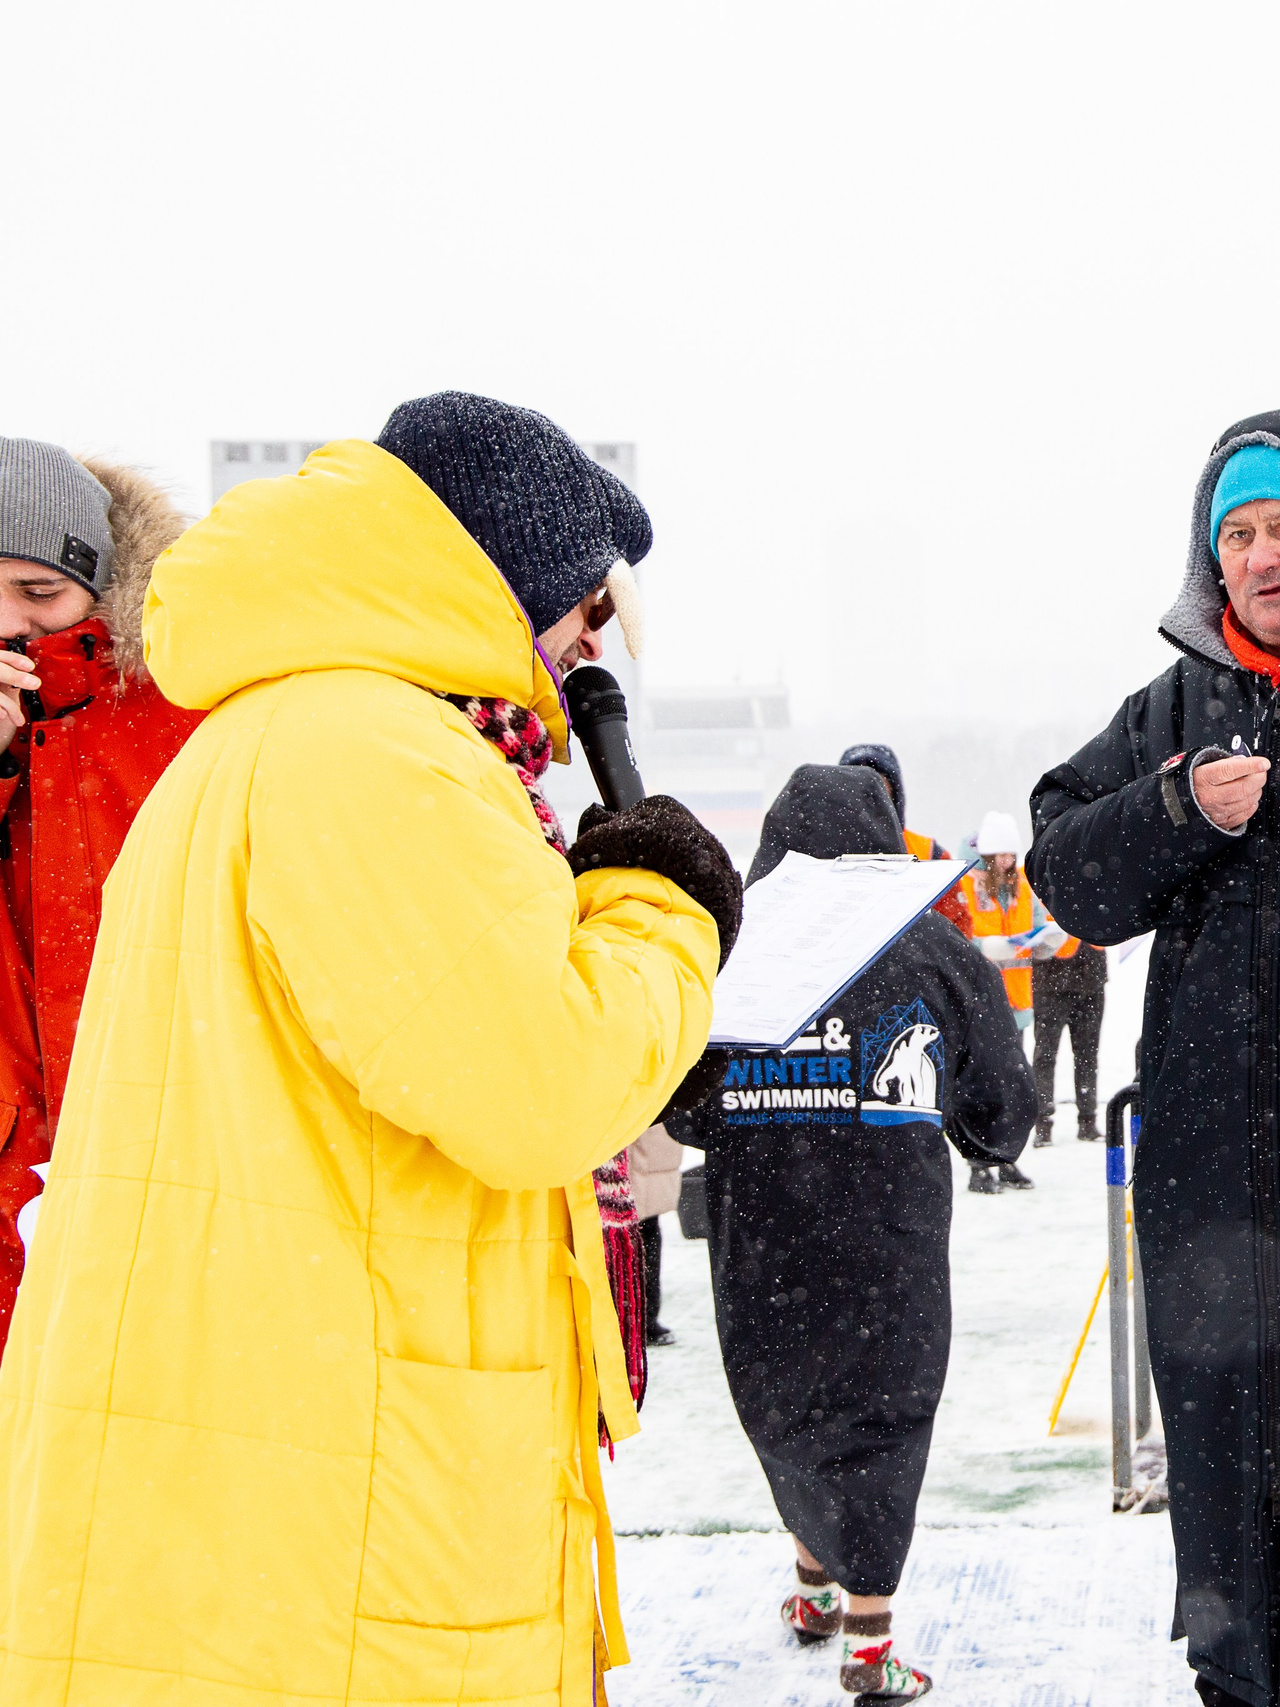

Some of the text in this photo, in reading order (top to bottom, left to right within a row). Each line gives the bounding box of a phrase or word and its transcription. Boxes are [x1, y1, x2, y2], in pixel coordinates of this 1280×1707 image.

[822, 1017, 852, 1051] &
[724, 1056, 853, 1087] WINTER
[721, 1088, 857, 1111] SWIMMING
[813, 1112, 853, 1124] RUSSIA
